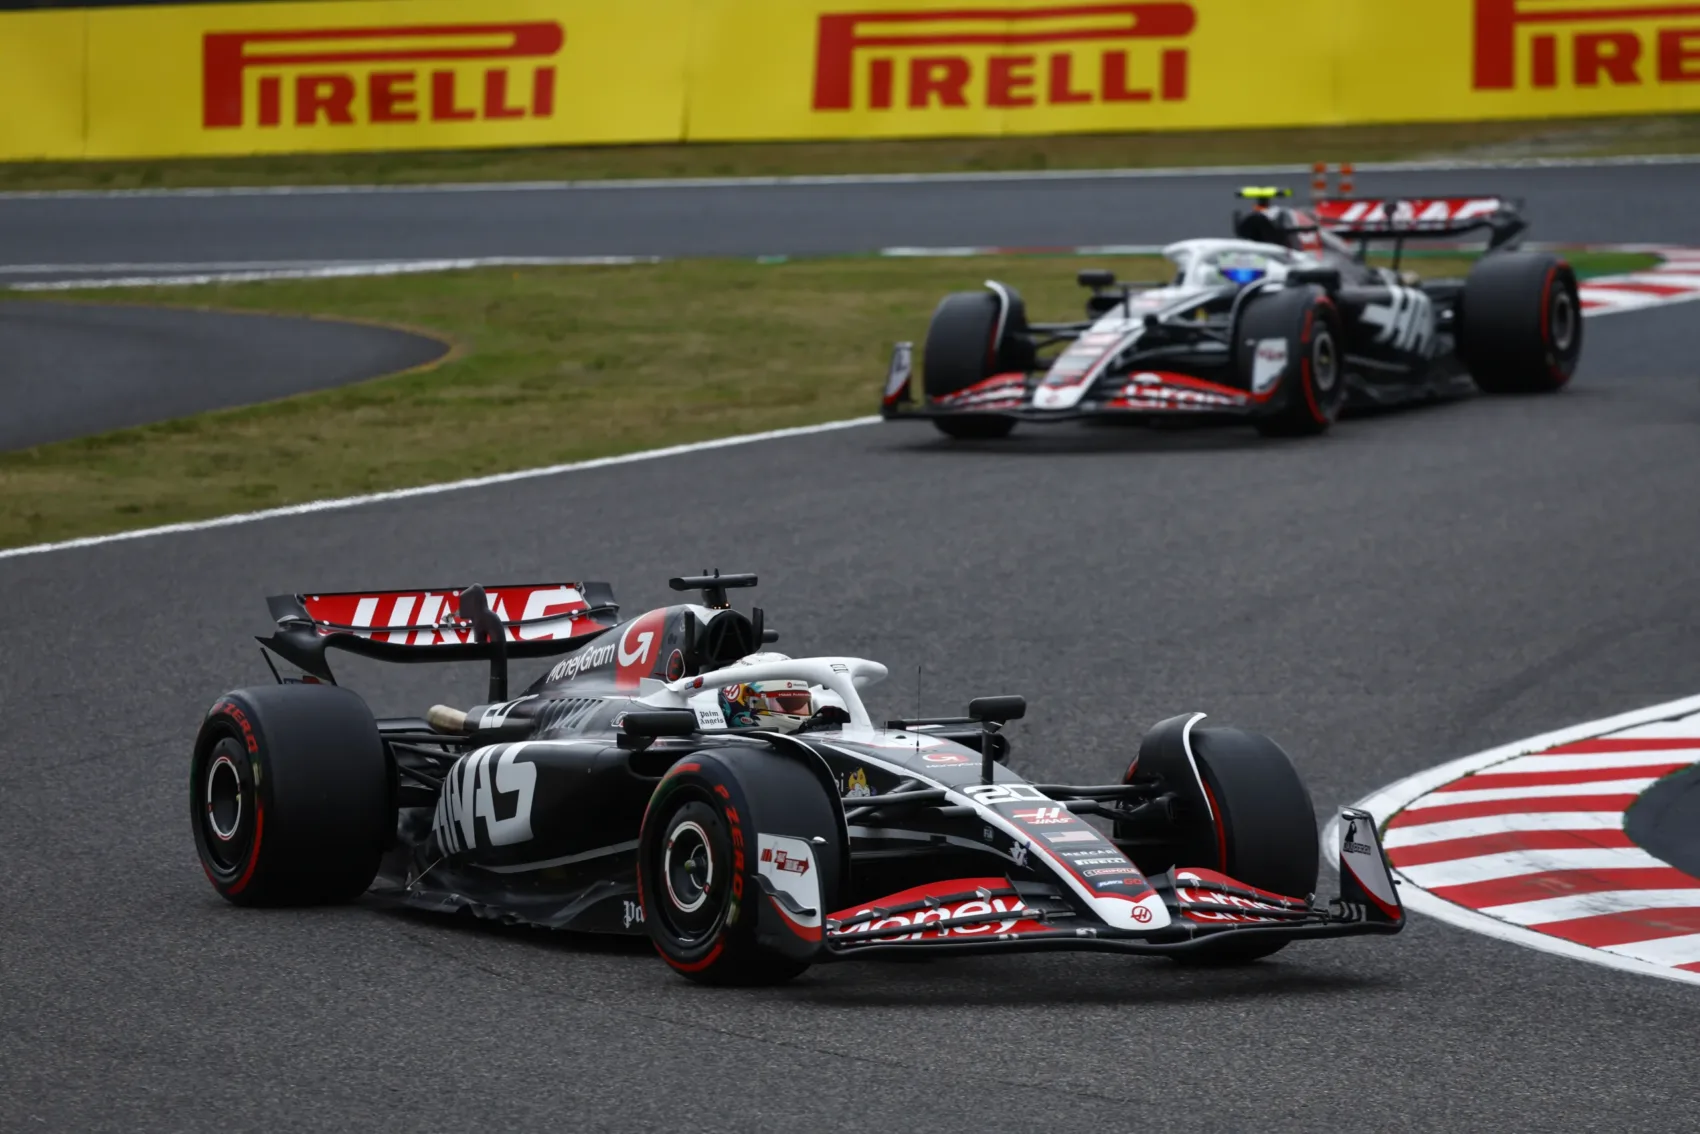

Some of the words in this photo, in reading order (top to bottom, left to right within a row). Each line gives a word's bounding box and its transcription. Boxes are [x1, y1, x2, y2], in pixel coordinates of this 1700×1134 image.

[811, 1, 1197, 112] PIRELLI
[1472, 0, 1700, 91] PIRE
[203, 21, 565, 128] PIRELLI
[546, 643, 616, 684] MoneyGram
[222, 703, 259, 753] ZERO
[963, 784, 1051, 806] 20
[725, 806, 745, 897] ZERO
[623, 900, 645, 928] Pa
[828, 898, 1027, 943] Money
